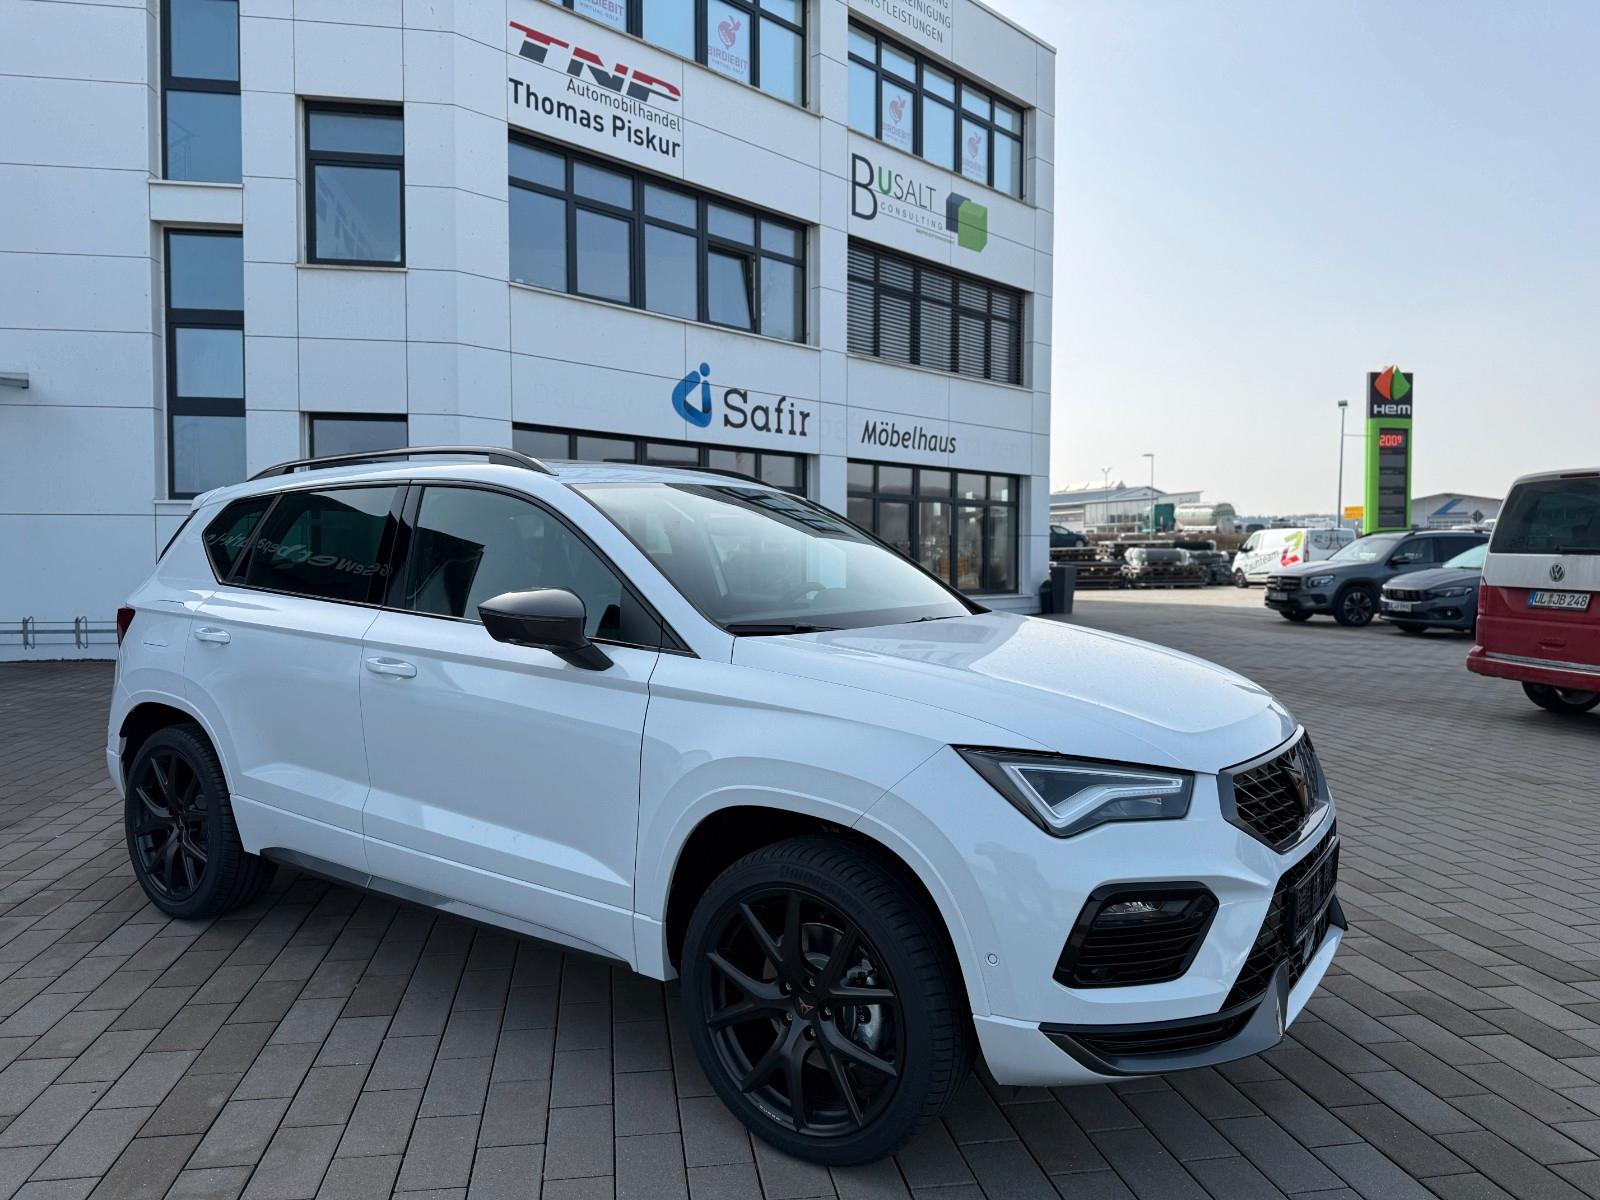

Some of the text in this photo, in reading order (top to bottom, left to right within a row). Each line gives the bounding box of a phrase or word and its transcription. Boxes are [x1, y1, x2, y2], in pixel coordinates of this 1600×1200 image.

[509, 21, 681, 102] TNP
[508, 77, 681, 159] Thomas Piskur
[566, 78, 681, 133] Automobilhandel
[880, 200, 943, 231] CONSULTING
[723, 388, 810, 437] Safir
[861, 420, 957, 453] Möbelhaus
